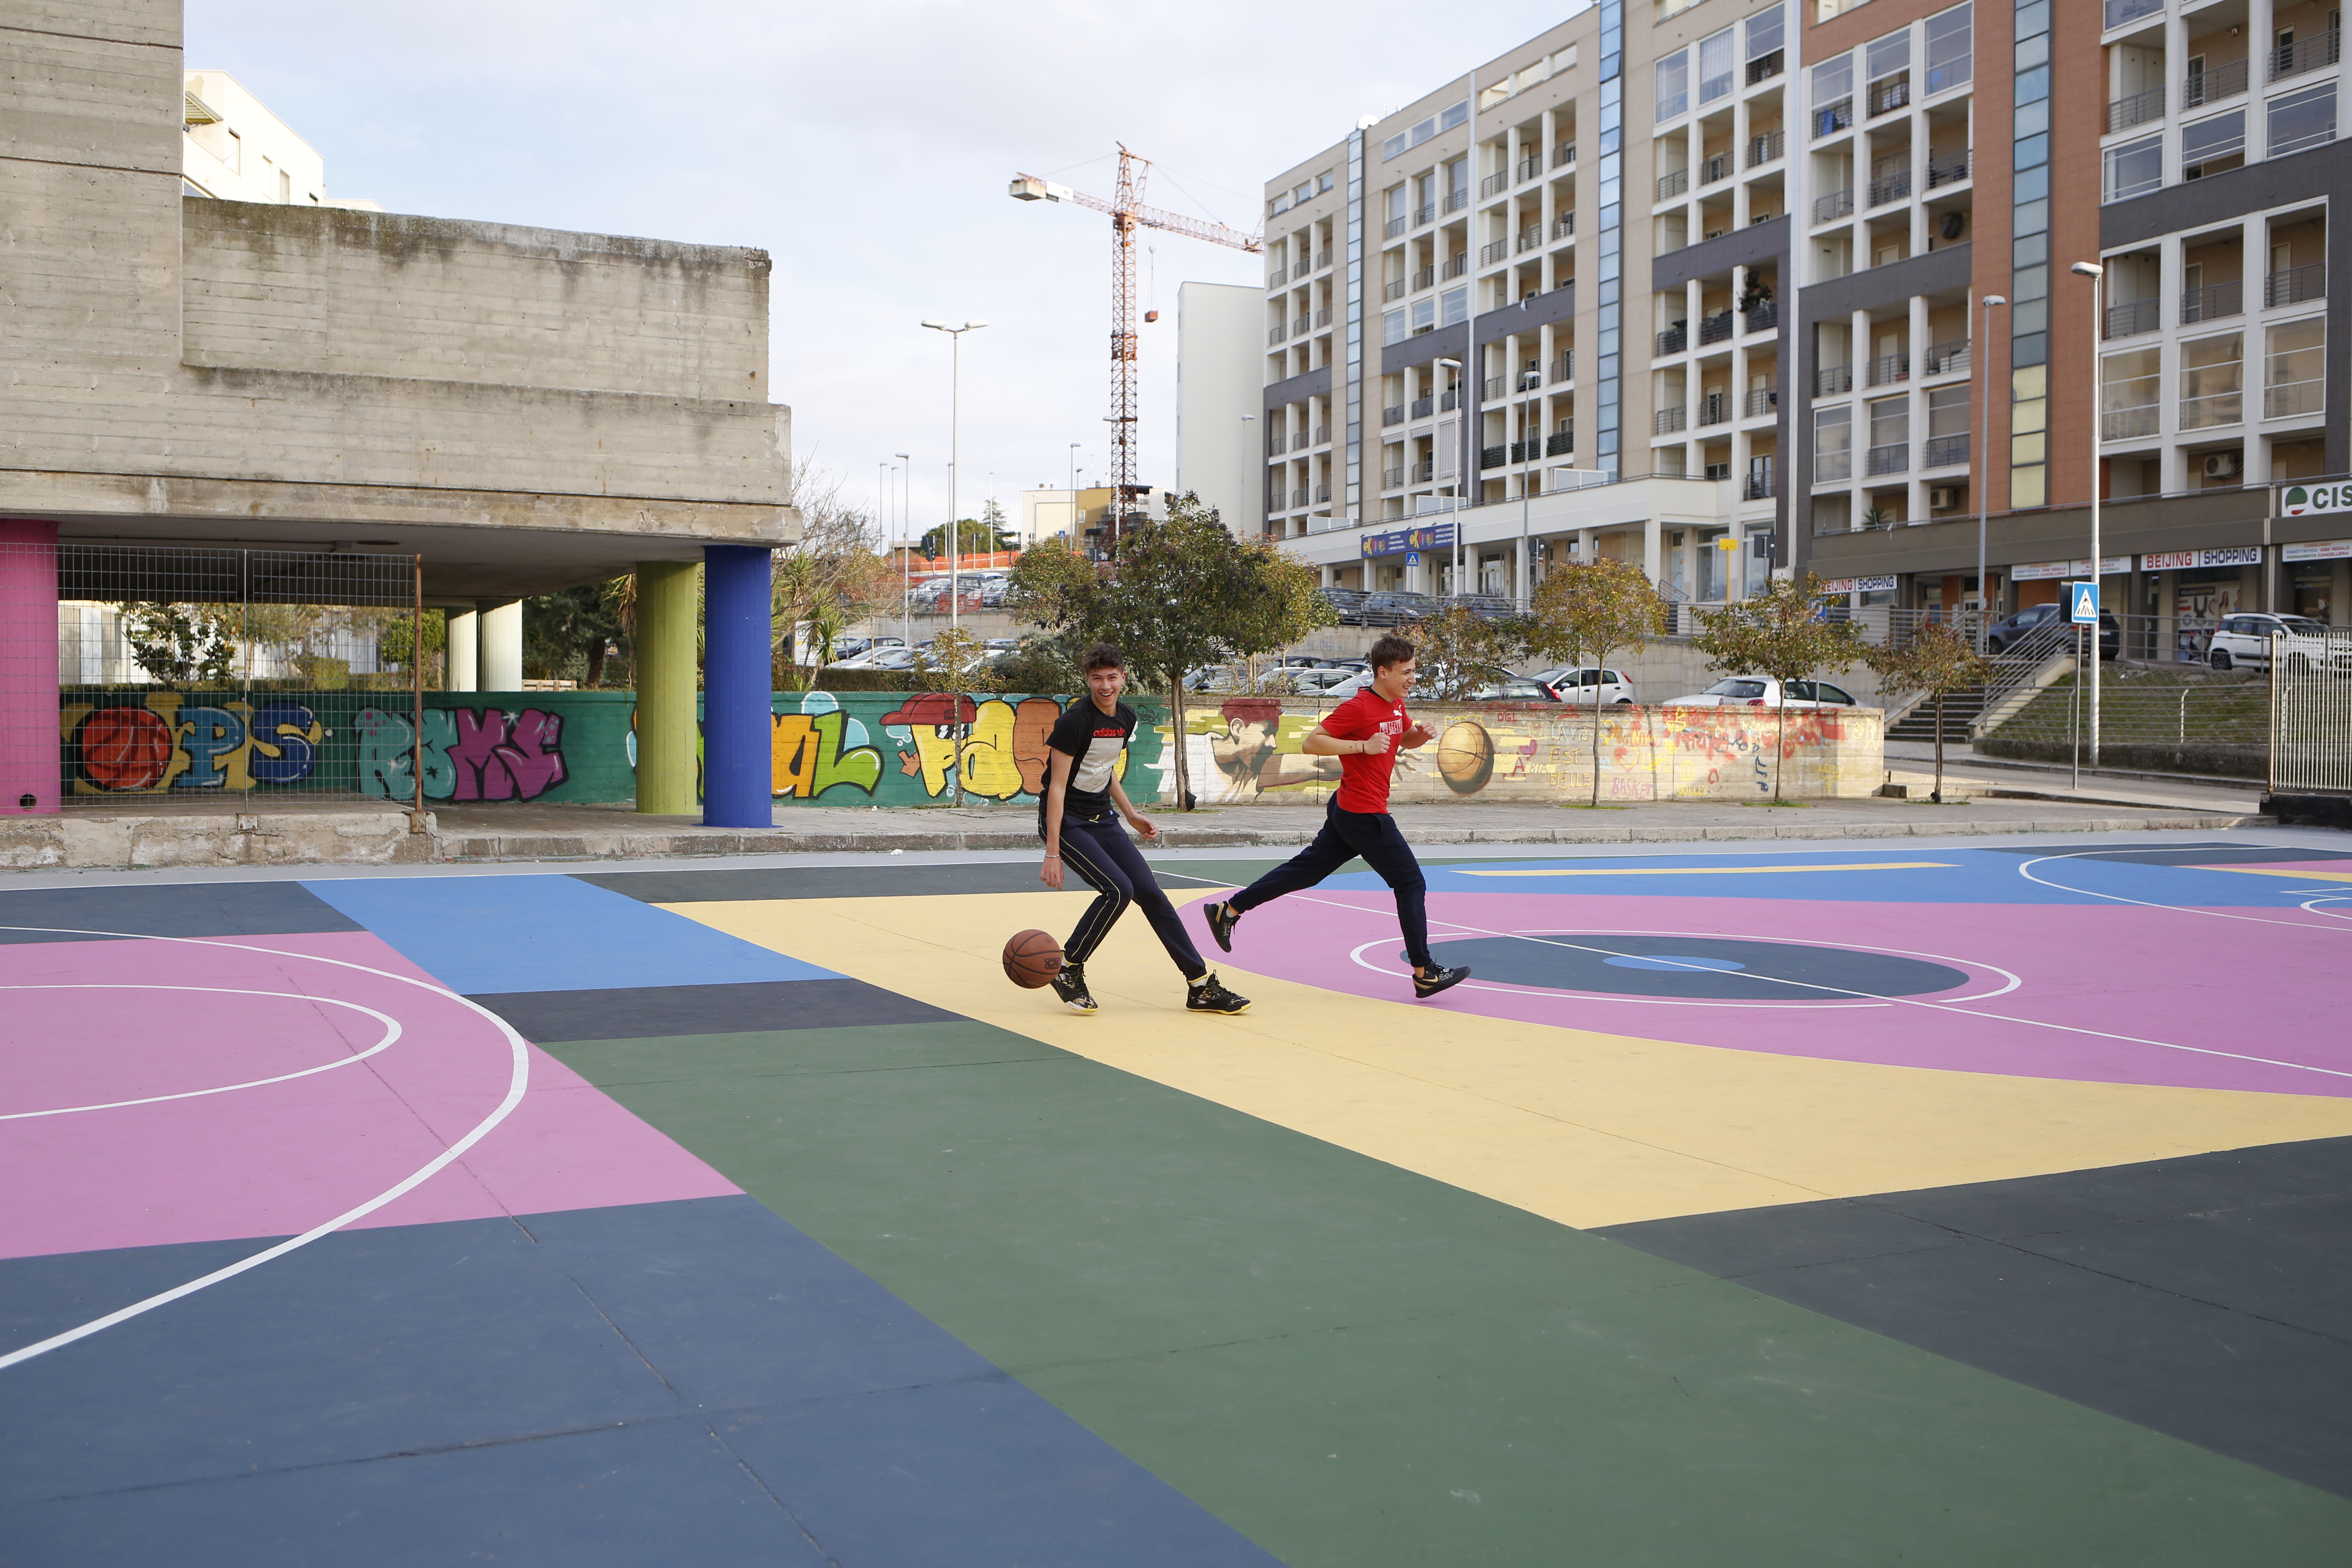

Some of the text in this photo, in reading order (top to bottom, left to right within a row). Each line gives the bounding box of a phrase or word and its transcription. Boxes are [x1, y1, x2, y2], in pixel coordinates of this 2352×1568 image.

[2147, 547, 2257, 568] BEIJING SHOPPING
[1858, 576, 1894, 590] SHOPPING
[1498, 712, 1517, 722] DGL
[1093, 727, 1116, 737] adidas
[1550, 746, 1583, 764] EST
[1819, 763, 1843, 778] LEIDY
[1549, 769, 1591, 790] BELLE
[1612, 777, 1653, 797] BASKET
[1676, 783, 1708, 796] VOLLEY
